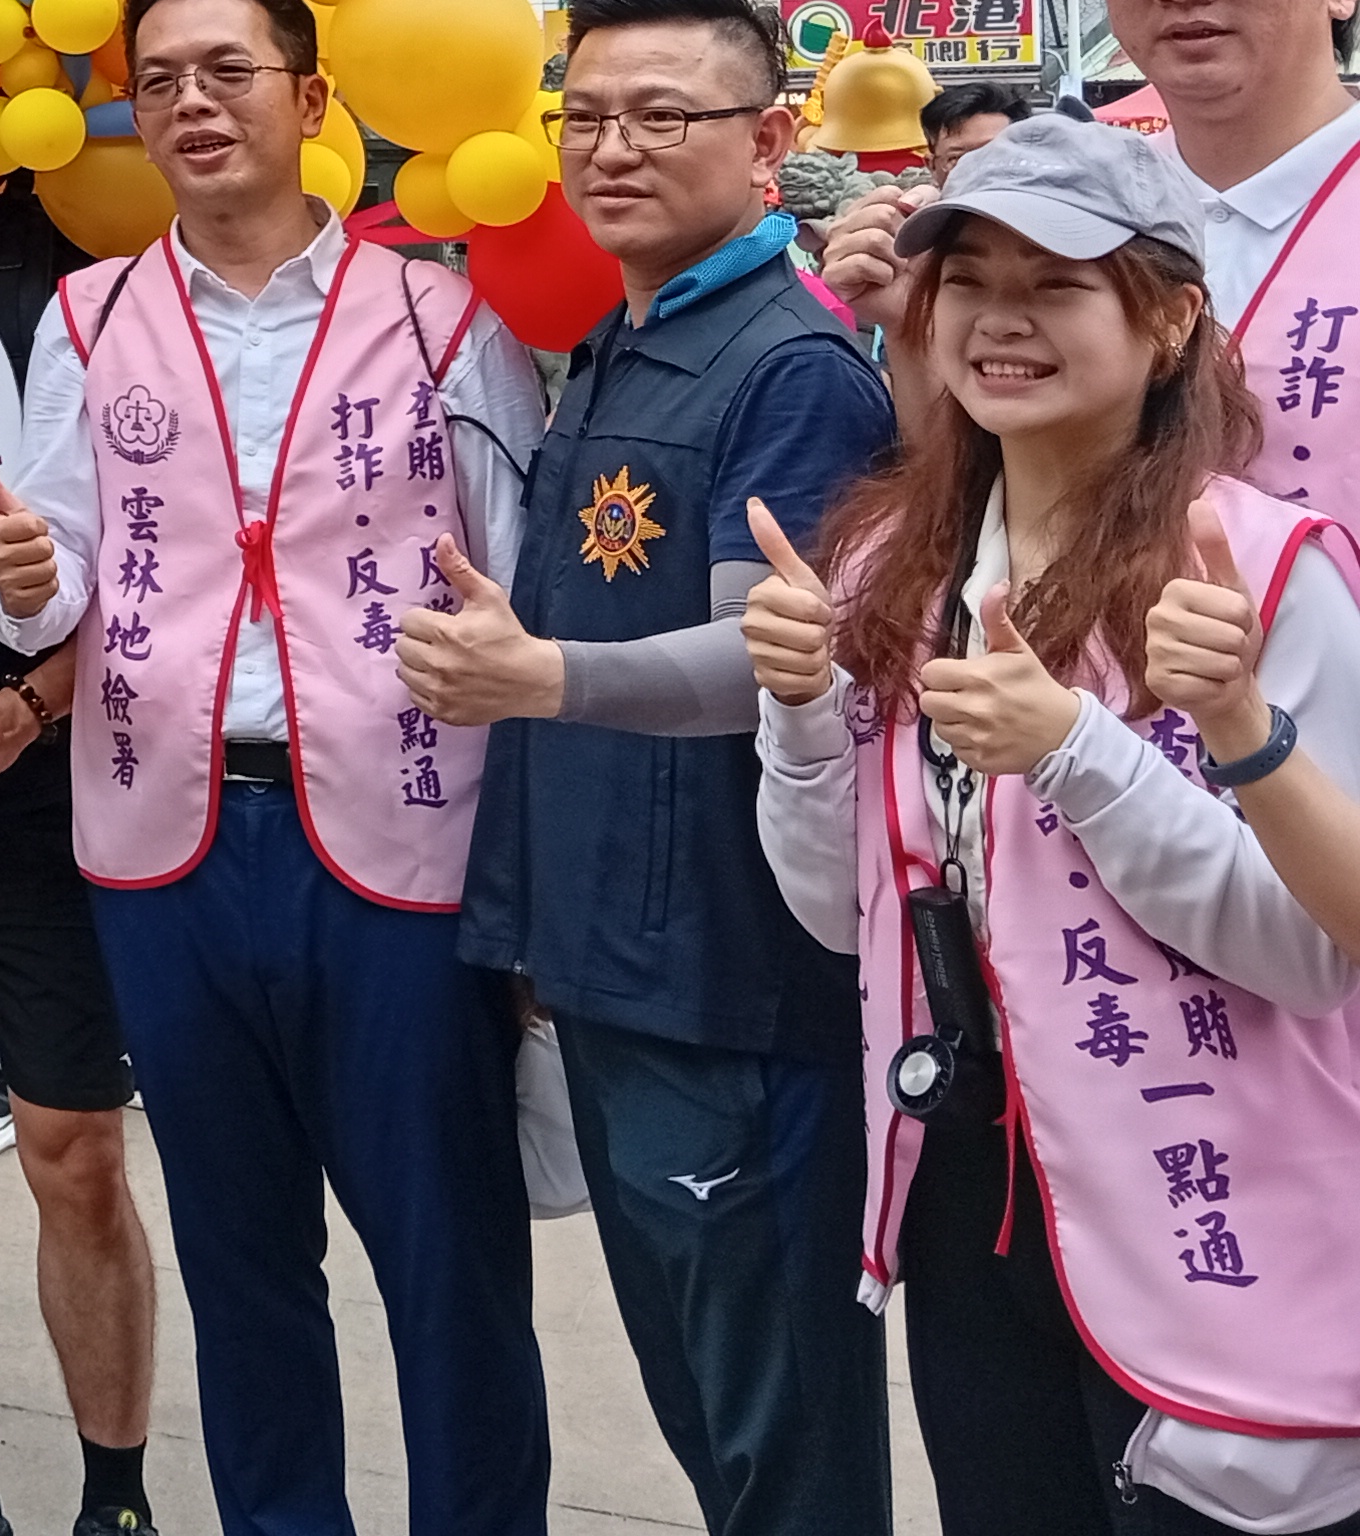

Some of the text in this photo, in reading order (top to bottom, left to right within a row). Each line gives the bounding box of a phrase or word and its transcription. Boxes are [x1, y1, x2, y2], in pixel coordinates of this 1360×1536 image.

[893, 38, 1022, 64] 榔行
[99, 486, 165, 791] 雲林地檢署
